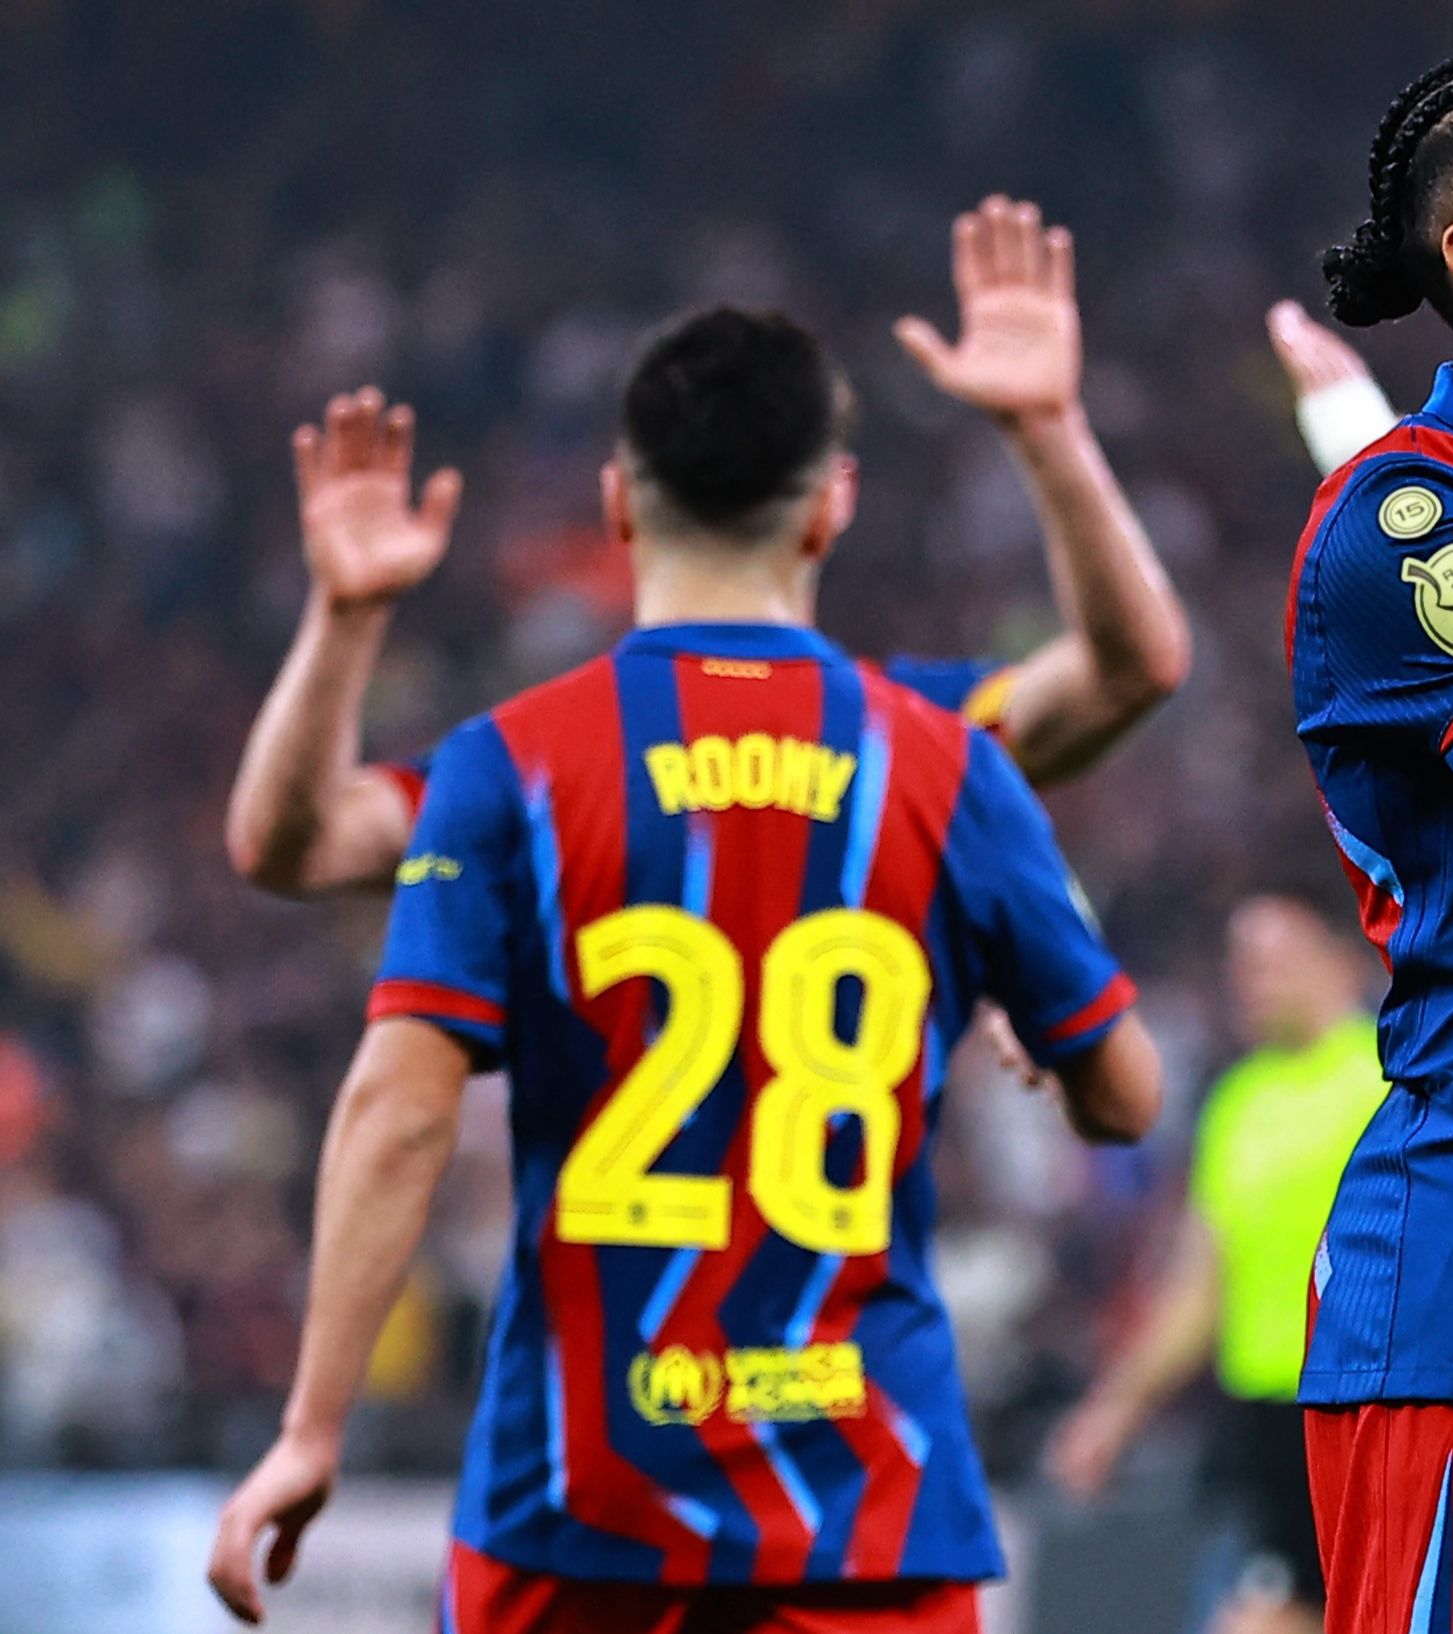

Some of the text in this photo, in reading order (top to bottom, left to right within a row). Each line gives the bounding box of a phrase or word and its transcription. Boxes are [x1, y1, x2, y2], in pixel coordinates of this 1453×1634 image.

[1395, 502, 1424, 521] 15
[646, 733, 856, 822] ROONY
[556, 904, 933, 1256] 28
